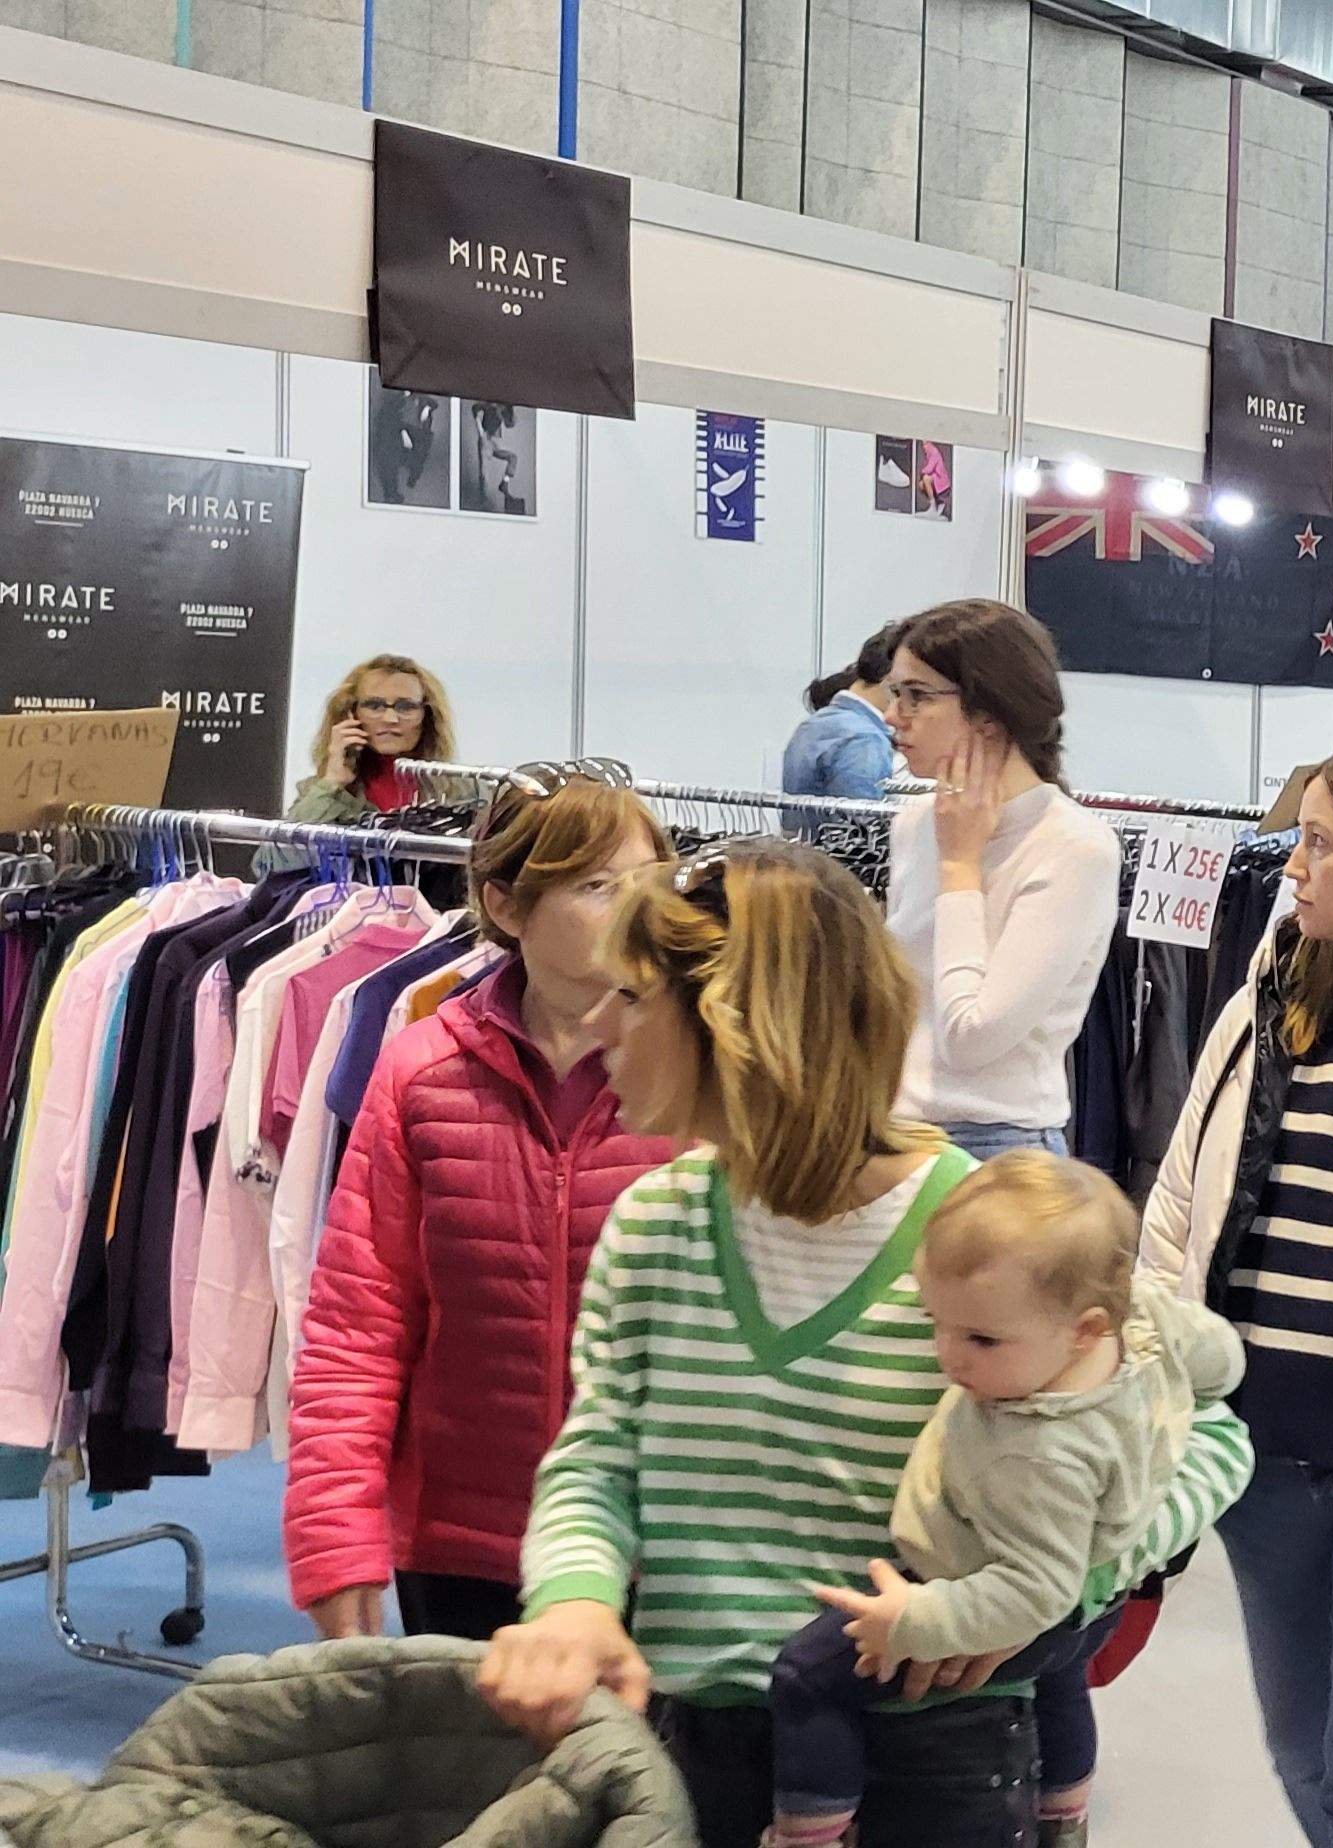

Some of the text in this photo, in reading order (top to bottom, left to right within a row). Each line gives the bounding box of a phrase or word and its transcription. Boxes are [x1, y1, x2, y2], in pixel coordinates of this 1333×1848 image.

[449, 236, 568, 285] MIRATE
[1246, 394, 1306, 425] MIRATE
[18, 489, 47, 503] PLAZA
[167, 493, 274, 523] MIRATE
[58, 505, 94, 520] HUESCA
[0, 581, 116, 611] MIRATE
[180, 602, 206, 615] PLAZA
[14, 695, 43, 708] PLAZA
[161, 690, 267, 714] MIRATE
[1146, 837, 1225, 882] 1 X 25€
[1135, 889, 1211, 932] 2 X 40€
